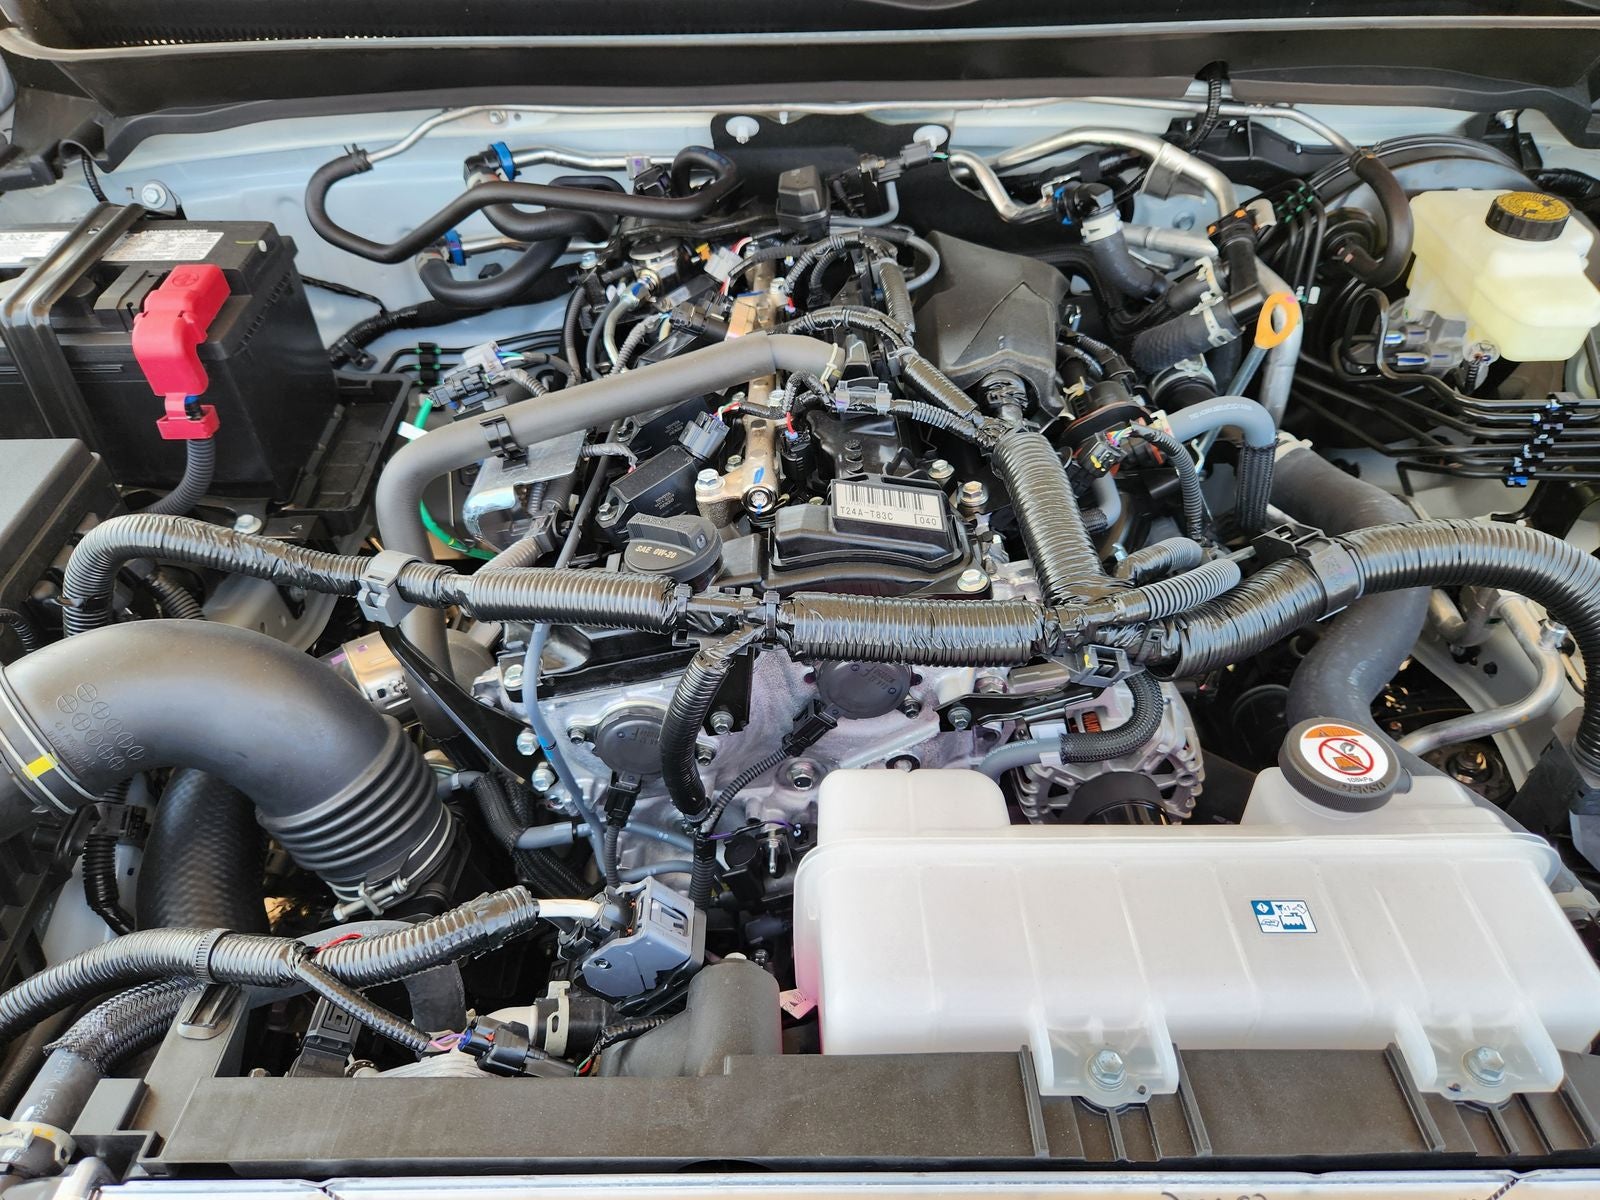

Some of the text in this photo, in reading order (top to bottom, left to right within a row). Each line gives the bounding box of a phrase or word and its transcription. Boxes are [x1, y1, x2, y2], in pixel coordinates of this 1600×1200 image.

[840, 506, 894, 520] T24A-T83C
[920, 516, 937, 526] 040
[634, 545, 678, 559] SAE 0W-20
